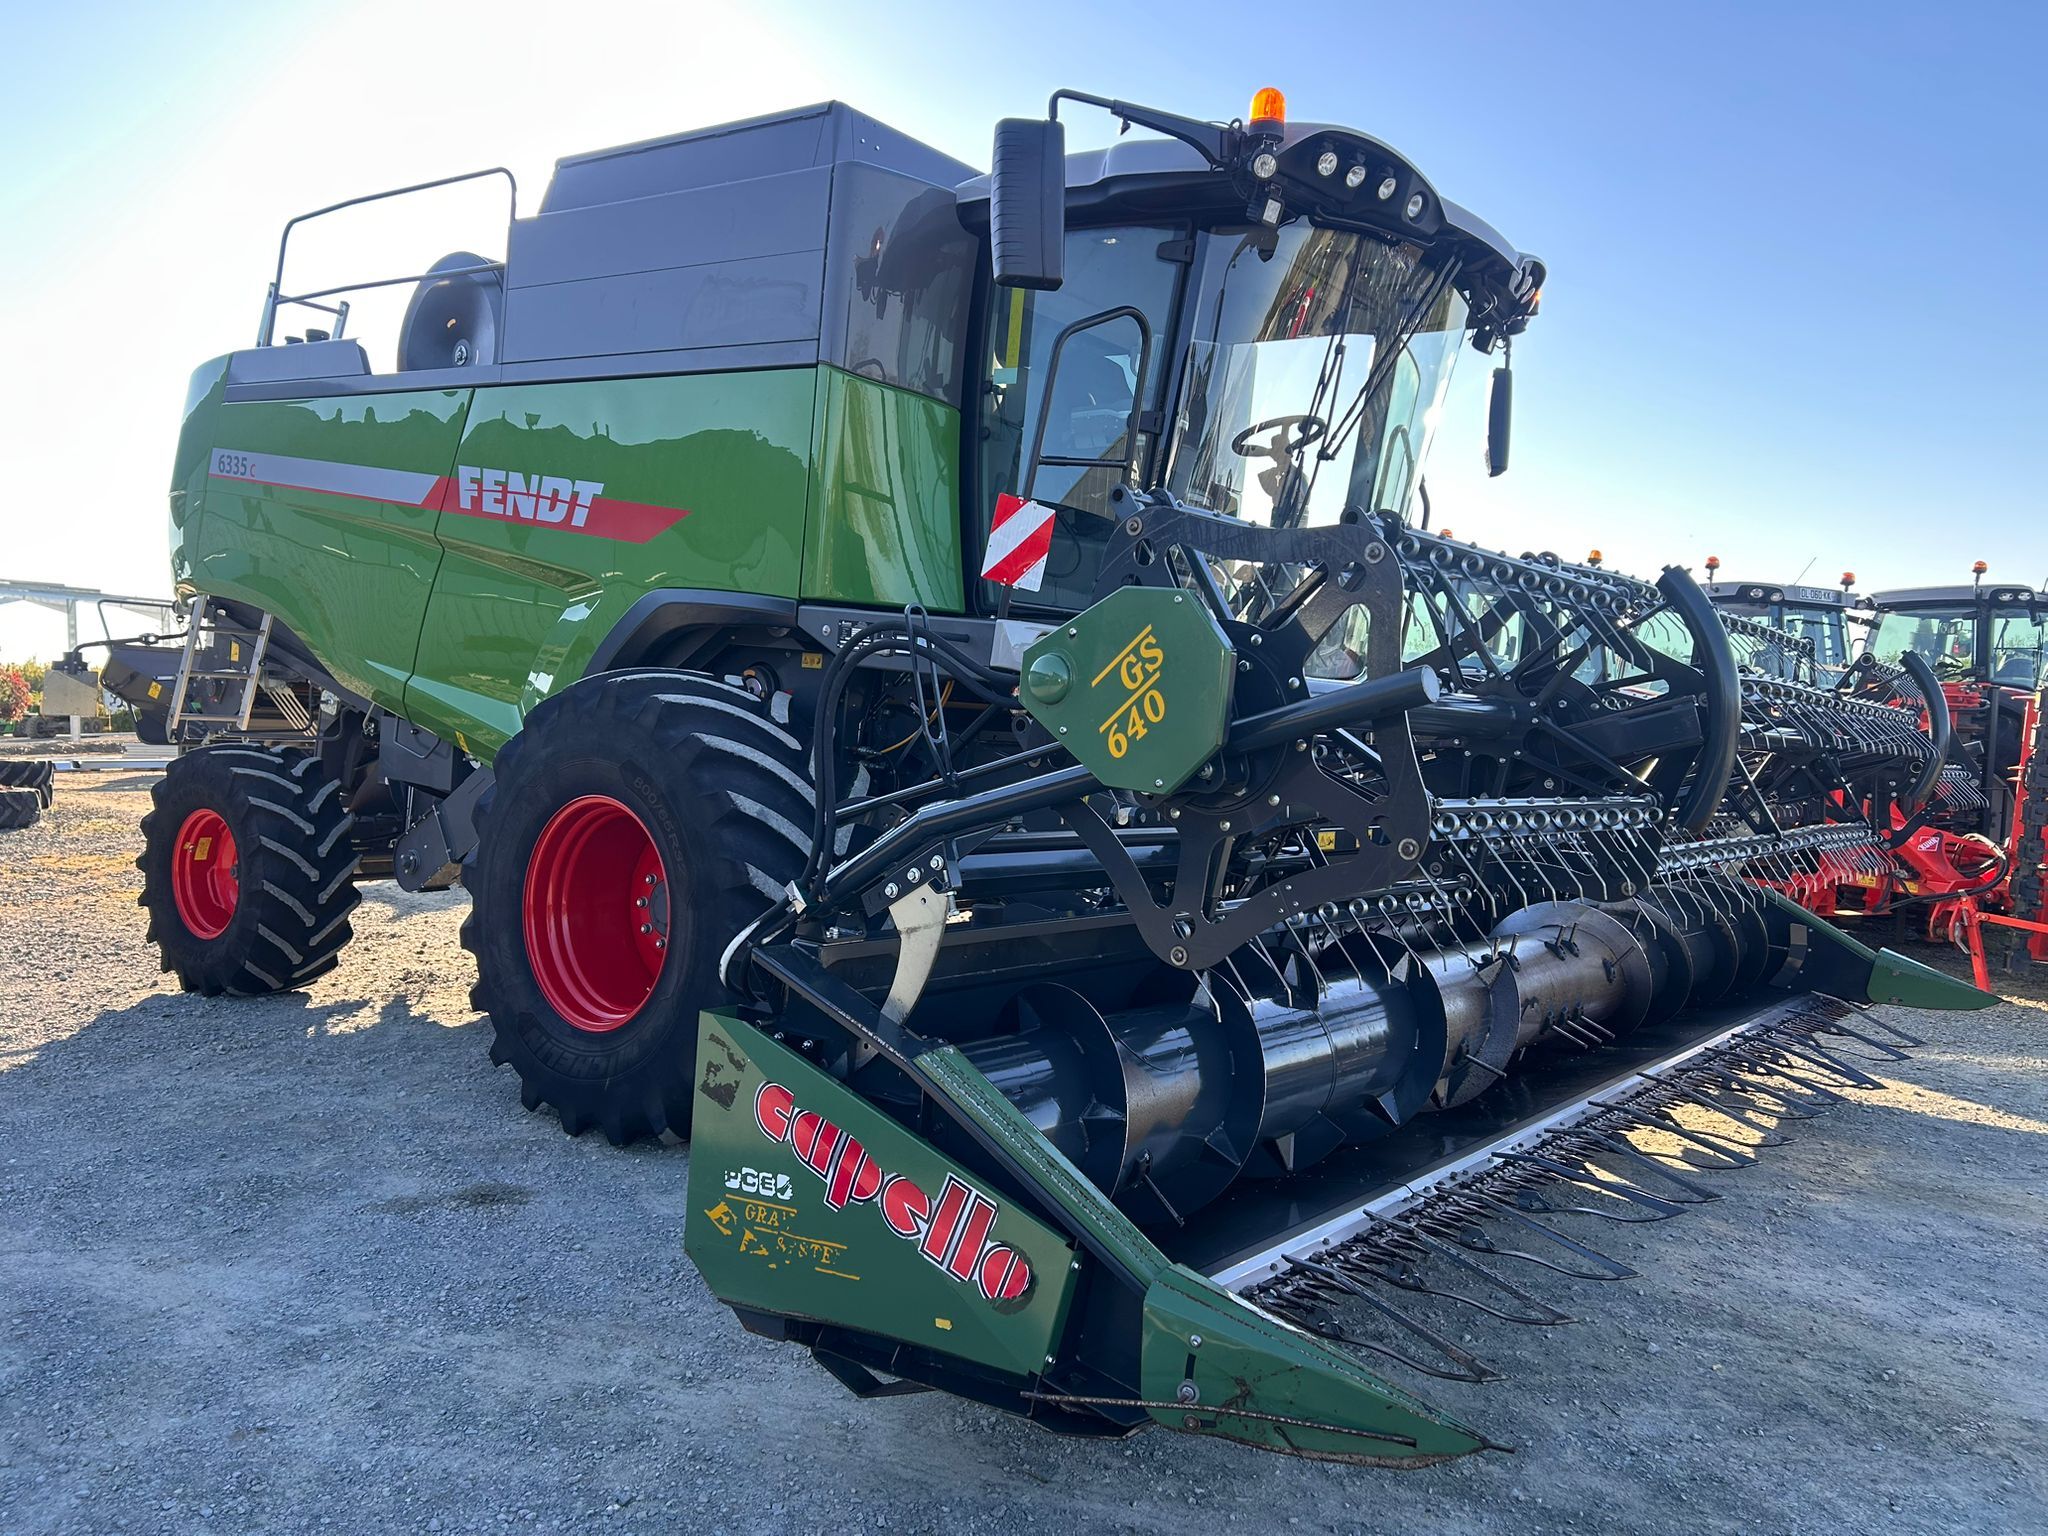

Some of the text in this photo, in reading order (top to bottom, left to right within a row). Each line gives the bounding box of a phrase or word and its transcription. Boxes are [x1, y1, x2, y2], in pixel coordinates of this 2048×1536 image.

[218, 454, 248, 477] 6335
[457, 465, 604, 528] FENDT
[1120, 635, 1164, 690] GS
[1107, 690, 1166, 759] 640
